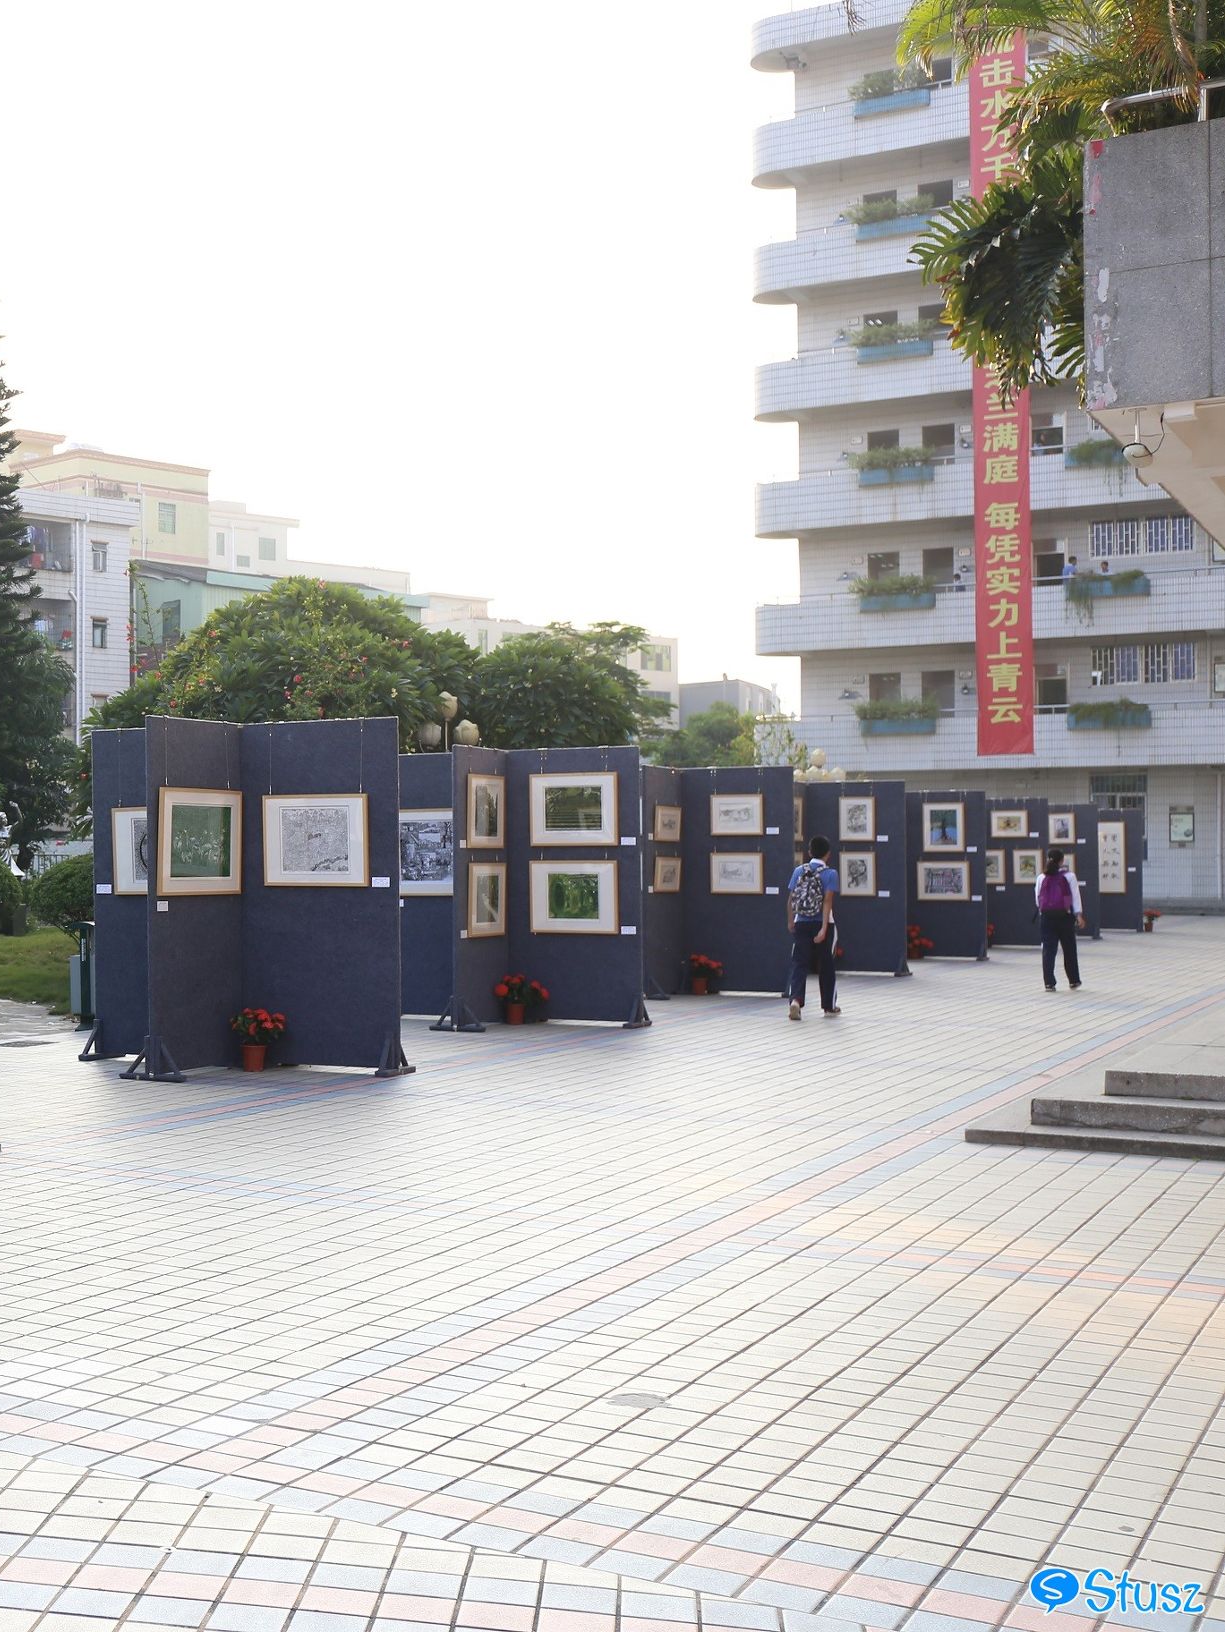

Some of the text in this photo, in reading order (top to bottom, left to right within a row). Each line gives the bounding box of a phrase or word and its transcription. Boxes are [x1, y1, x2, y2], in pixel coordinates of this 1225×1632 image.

[984, 502, 1024, 725] 每凭实力上青云
